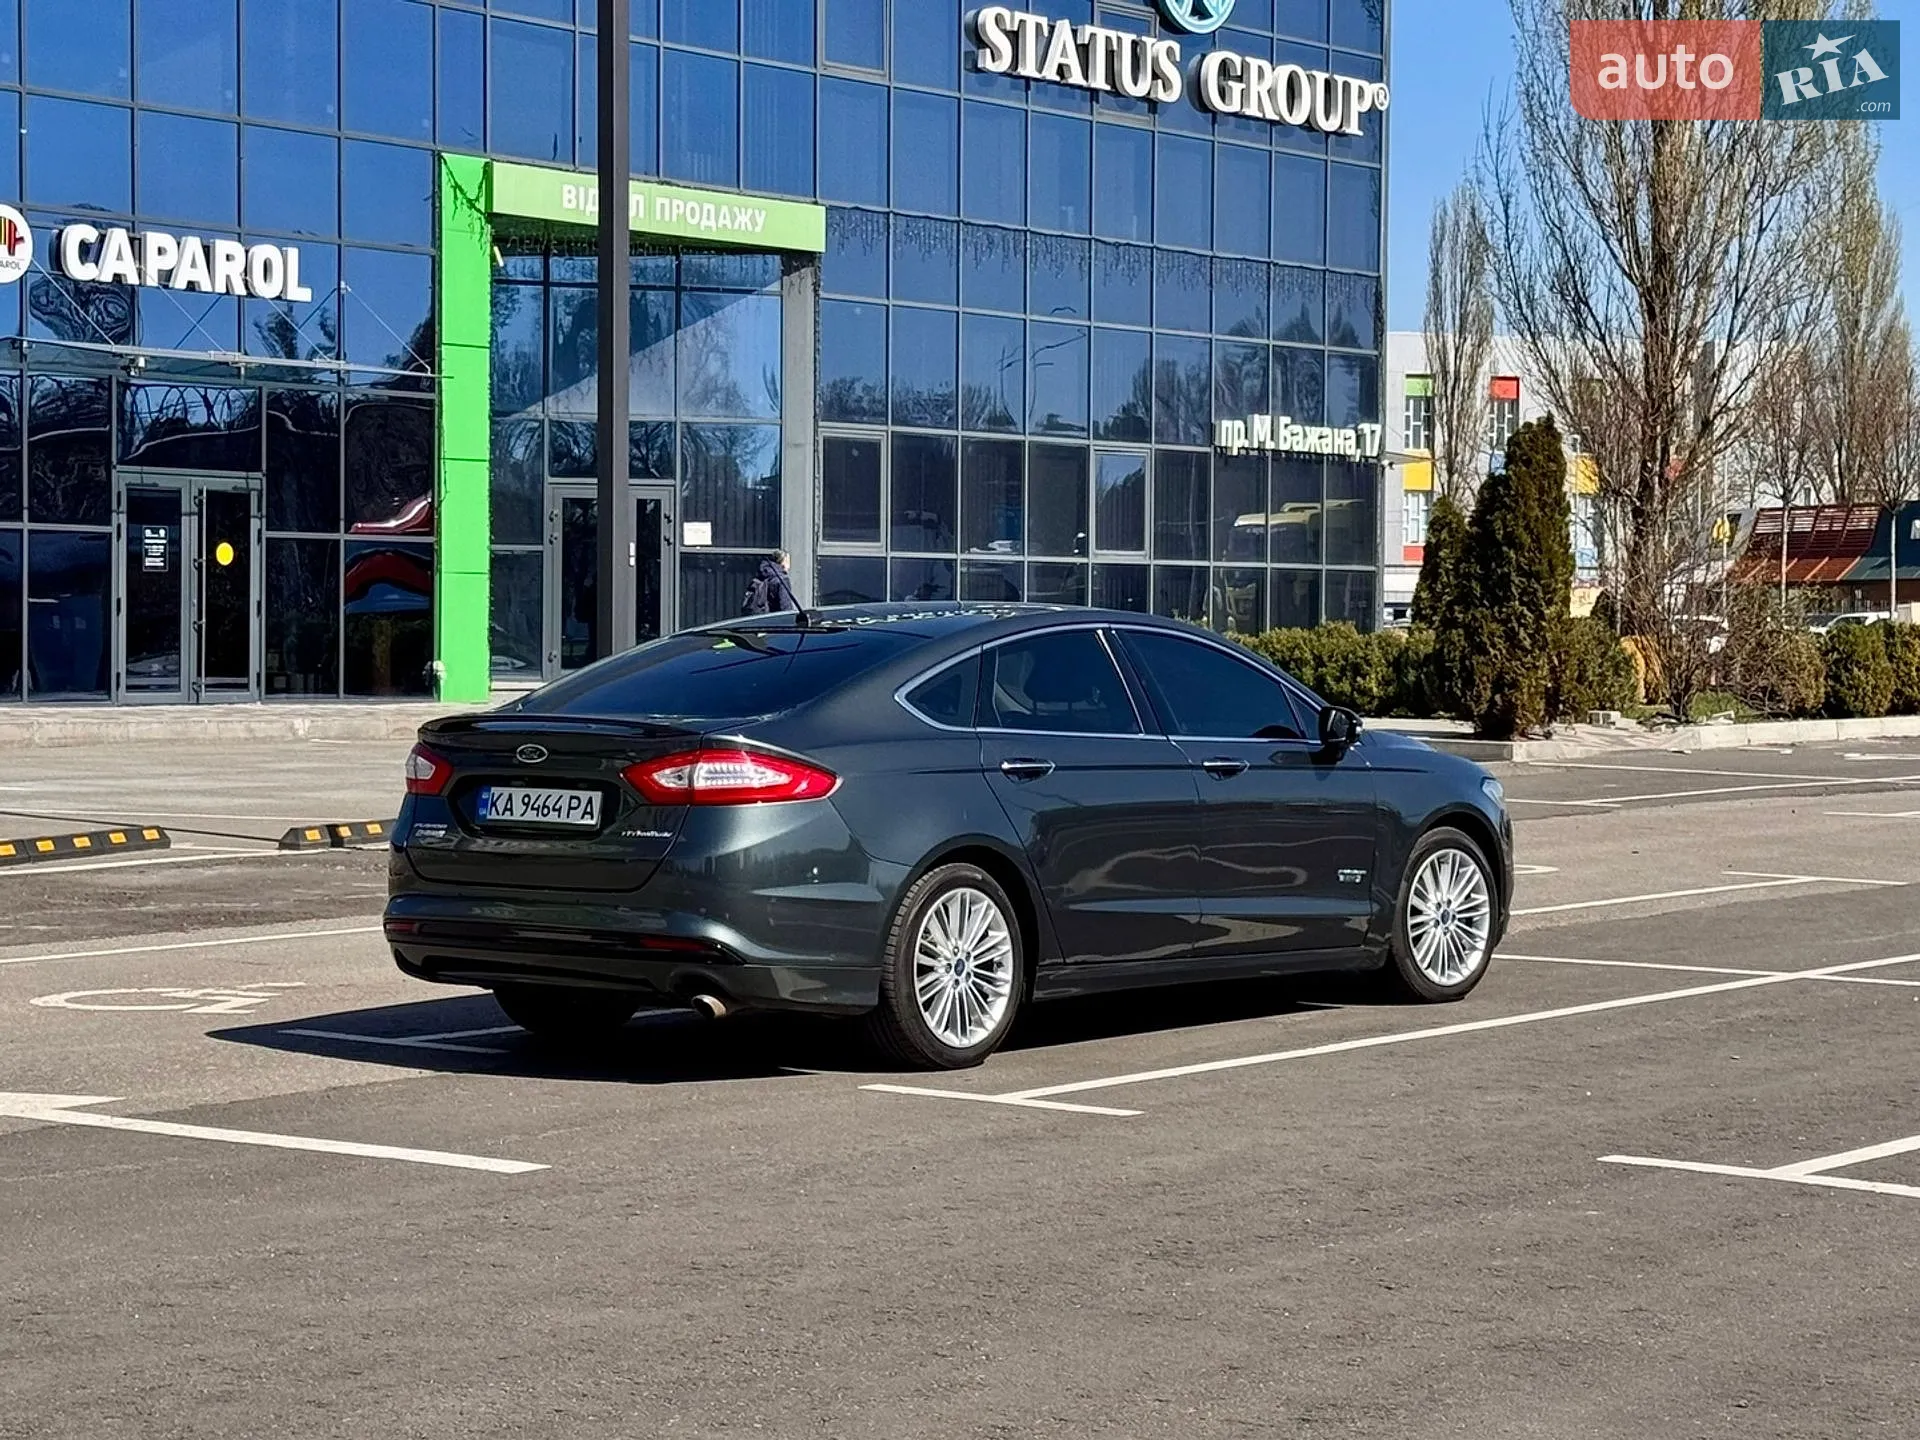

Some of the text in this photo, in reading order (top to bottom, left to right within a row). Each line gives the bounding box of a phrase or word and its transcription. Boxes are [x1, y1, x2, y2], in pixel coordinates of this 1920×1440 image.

[977, 6, 1182, 103] STATUS
[655, 197, 767, 233] ПРОДАЖУ
[60, 224, 313, 303] CAPAROL
[1252, 413, 1276, 450] М.
[489, 792, 595, 821] KA 9464 PA
